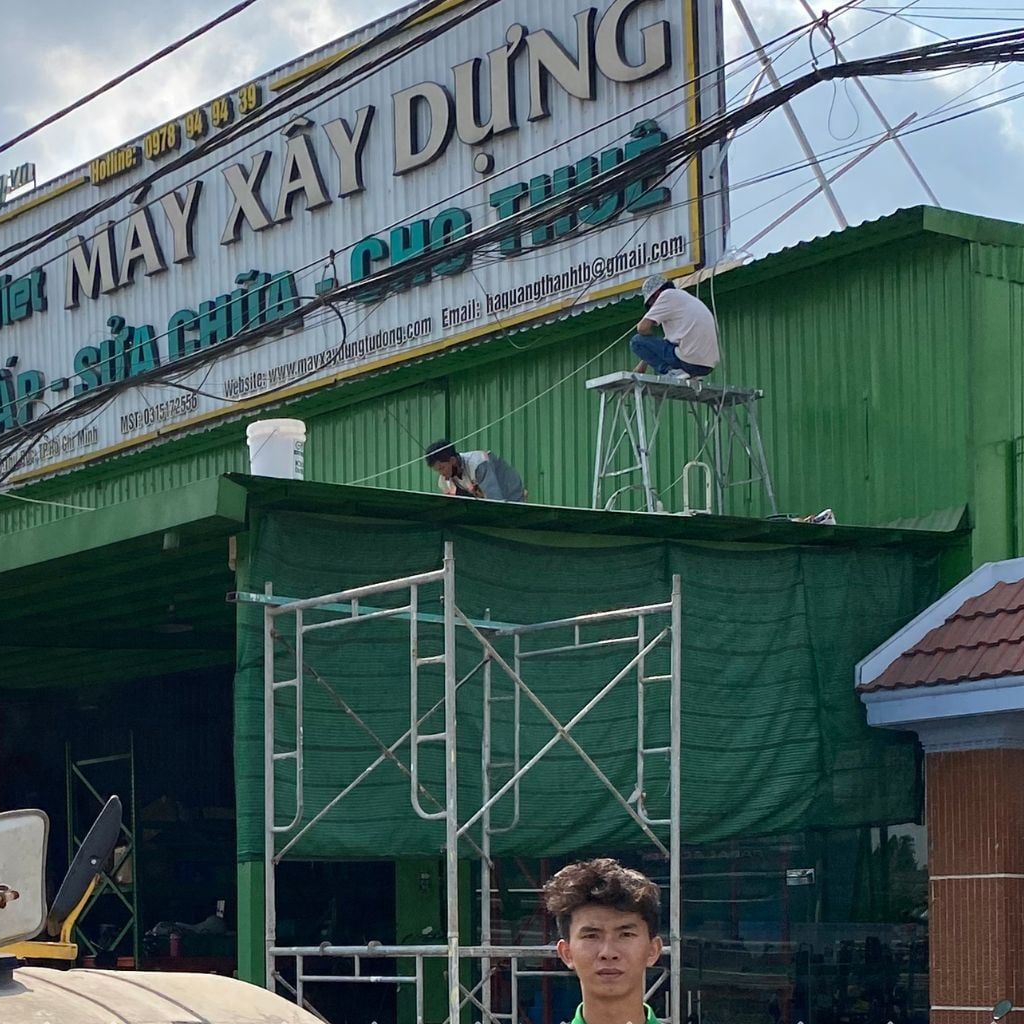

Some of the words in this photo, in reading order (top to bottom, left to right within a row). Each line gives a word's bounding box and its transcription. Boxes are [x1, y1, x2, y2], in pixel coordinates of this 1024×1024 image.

[64, 180, 204, 310] MÁY
[220, 104, 376, 246] XÂY
[393, 0, 672, 177] DỰNG
[89, 144, 139, 186] Hotline:
[144, 123, 178, 161] 0978
[184, 110, 205, 140] 94
[210, 98, 231, 128] 94
[238, 83, 259, 115] 39
[73, 314, 160, 397] SỬA
[167, 268, 304, 363] CHỮA
[349, 206, 474, 303] CHO
[489, 118, 673, 256] THUÊ
[224, 371, 268, 398] Website:
[441, 302, 481, 329] Email:
[486, 234, 685, 314] haquangthanhtb@gmail.com
[77, 426, 98, 448] Minh
